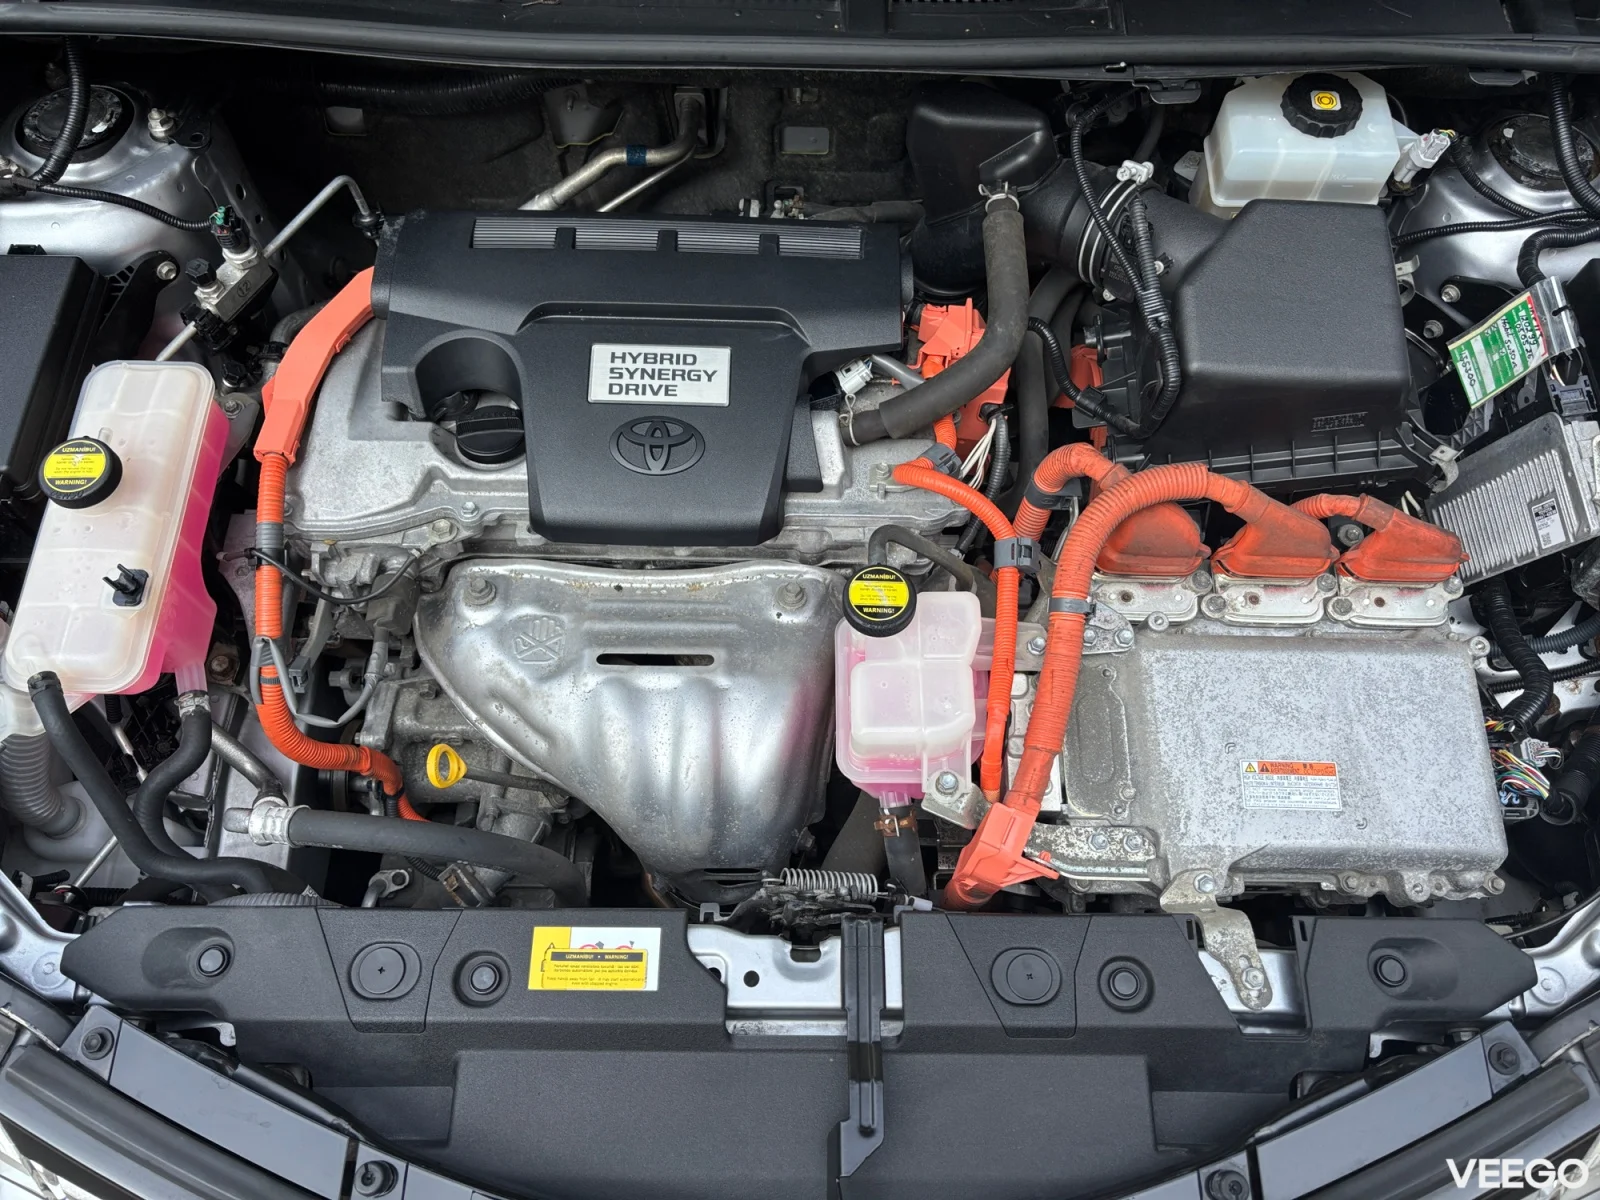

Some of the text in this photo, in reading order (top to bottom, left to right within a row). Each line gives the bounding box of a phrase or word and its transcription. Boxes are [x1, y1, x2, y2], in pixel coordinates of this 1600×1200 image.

[610, 352, 698, 366] HYBRID
[609, 367, 718, 382] SYNERGY
[608, 383, 678, 397] DRIVE
